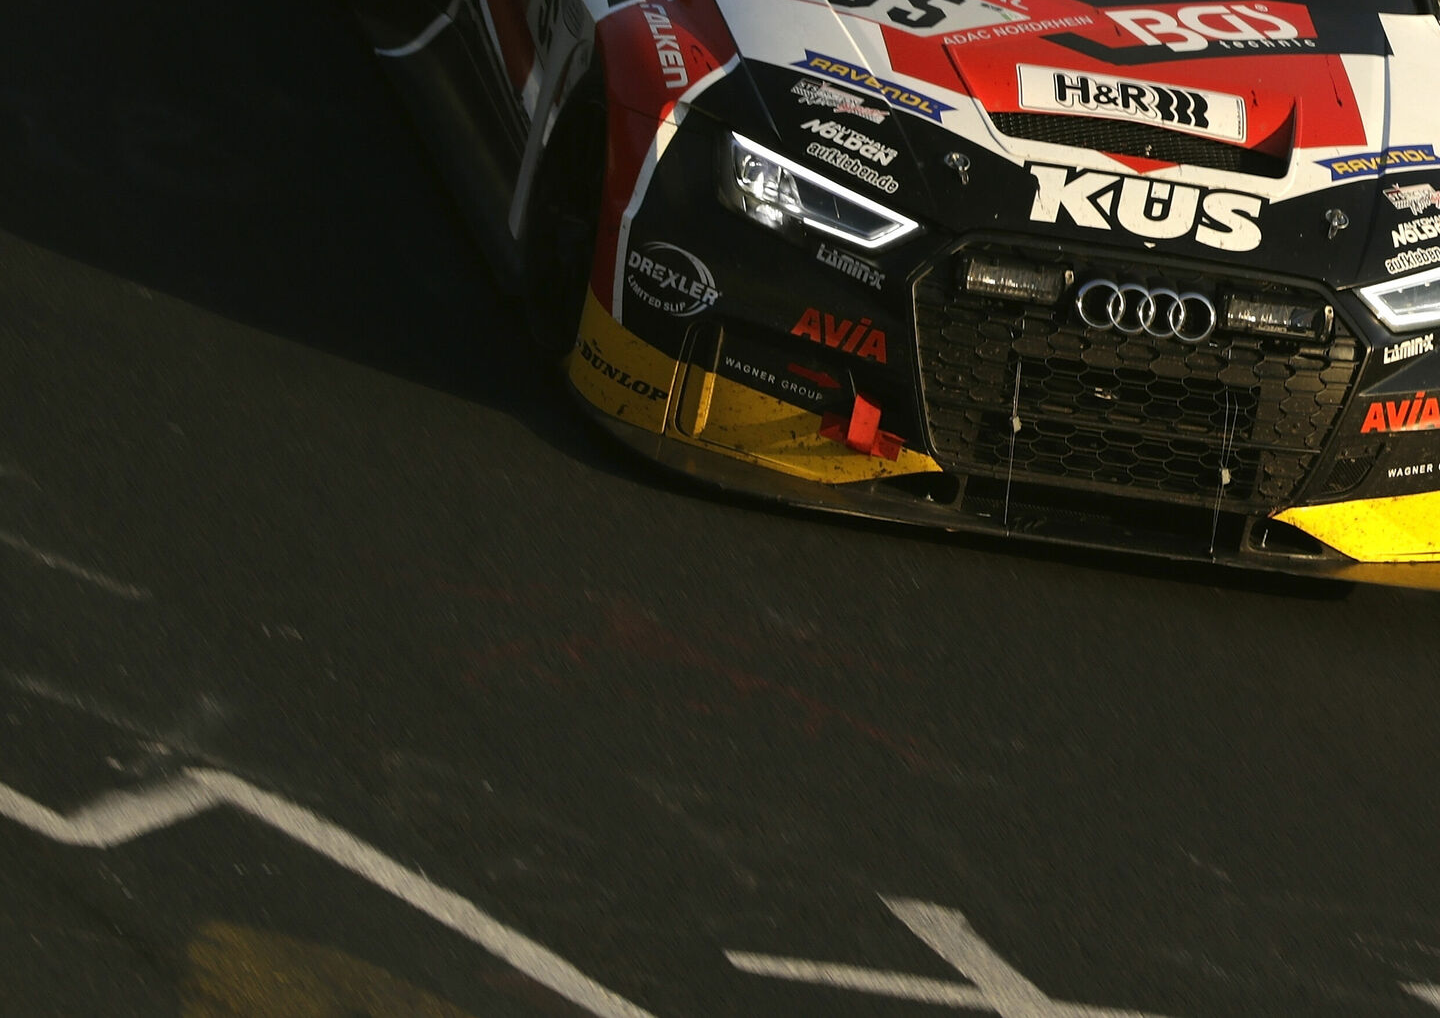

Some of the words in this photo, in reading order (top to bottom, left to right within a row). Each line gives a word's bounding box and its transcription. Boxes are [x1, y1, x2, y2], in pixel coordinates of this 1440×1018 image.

[640, 2, 689, 90] FALKEN
[942, 29, 992, 46] ADAC
[993, 14, 1094, 38] NORDRHEIN
[809, 55, 939, 118] RAVENOL
[1054, 72, 1156, 119] H&R
[805, 141, 900, 195] aufkleben.de
[1331, 147, 1436, 176] RAVENOL
[626, 274, 662, 311] LIMITED
[627, 249, 720, 308] DREXLER
[577, 340, 669, 403] DUNLOP
[724, 355, 777, 386] WAGNER
[780, 379, 824, 403] GROUP
[1387, 460, 1435, 478] WAGNER
